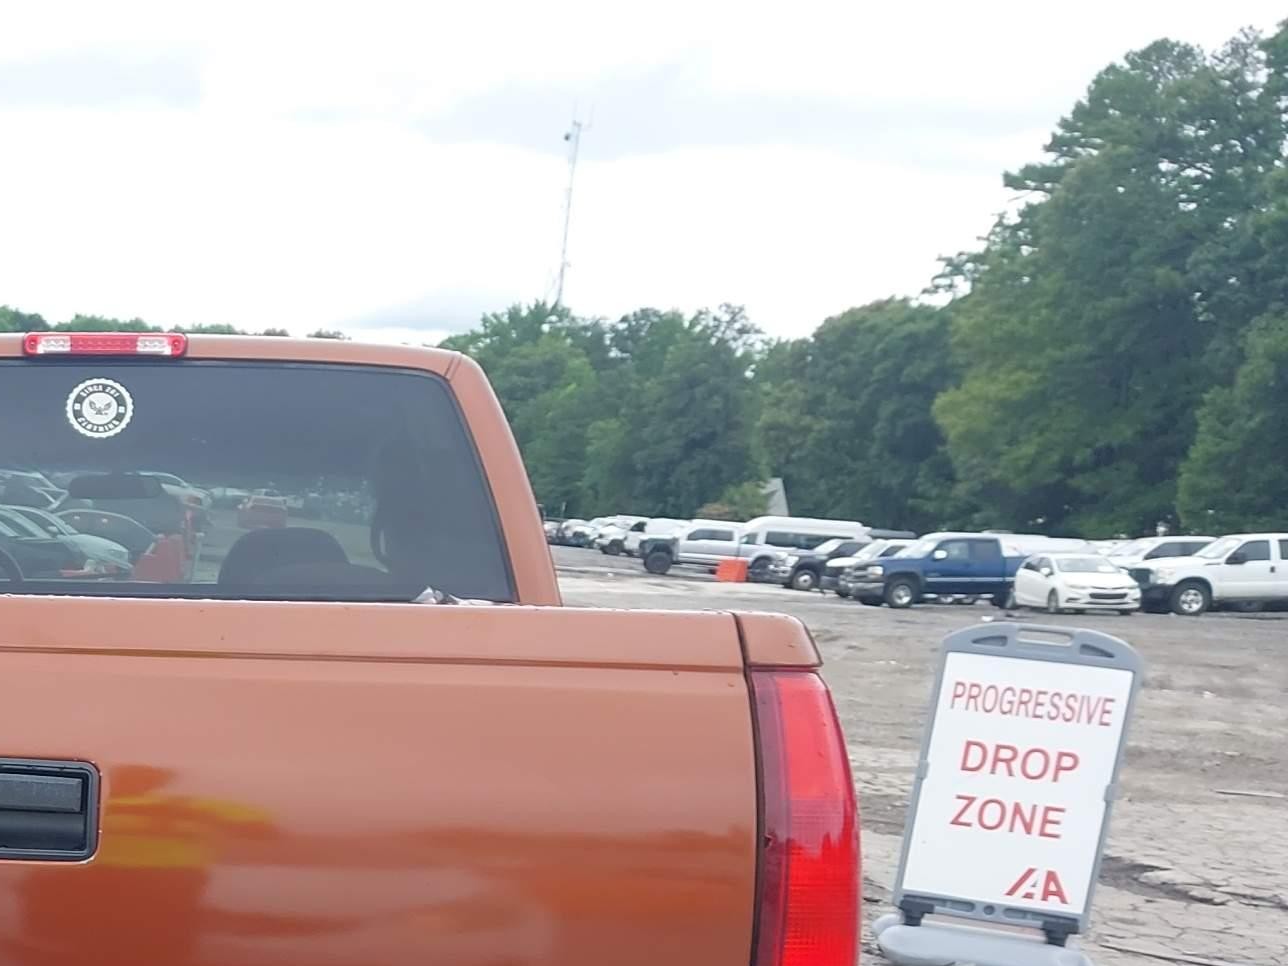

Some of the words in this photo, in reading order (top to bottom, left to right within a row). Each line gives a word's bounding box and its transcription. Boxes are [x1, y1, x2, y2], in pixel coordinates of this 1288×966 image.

[950, 681, 1115, 727] PROGRESSIVE
[960, 739, 1080, 783] DROP
[949, 794, 1066, 839] ZONE
